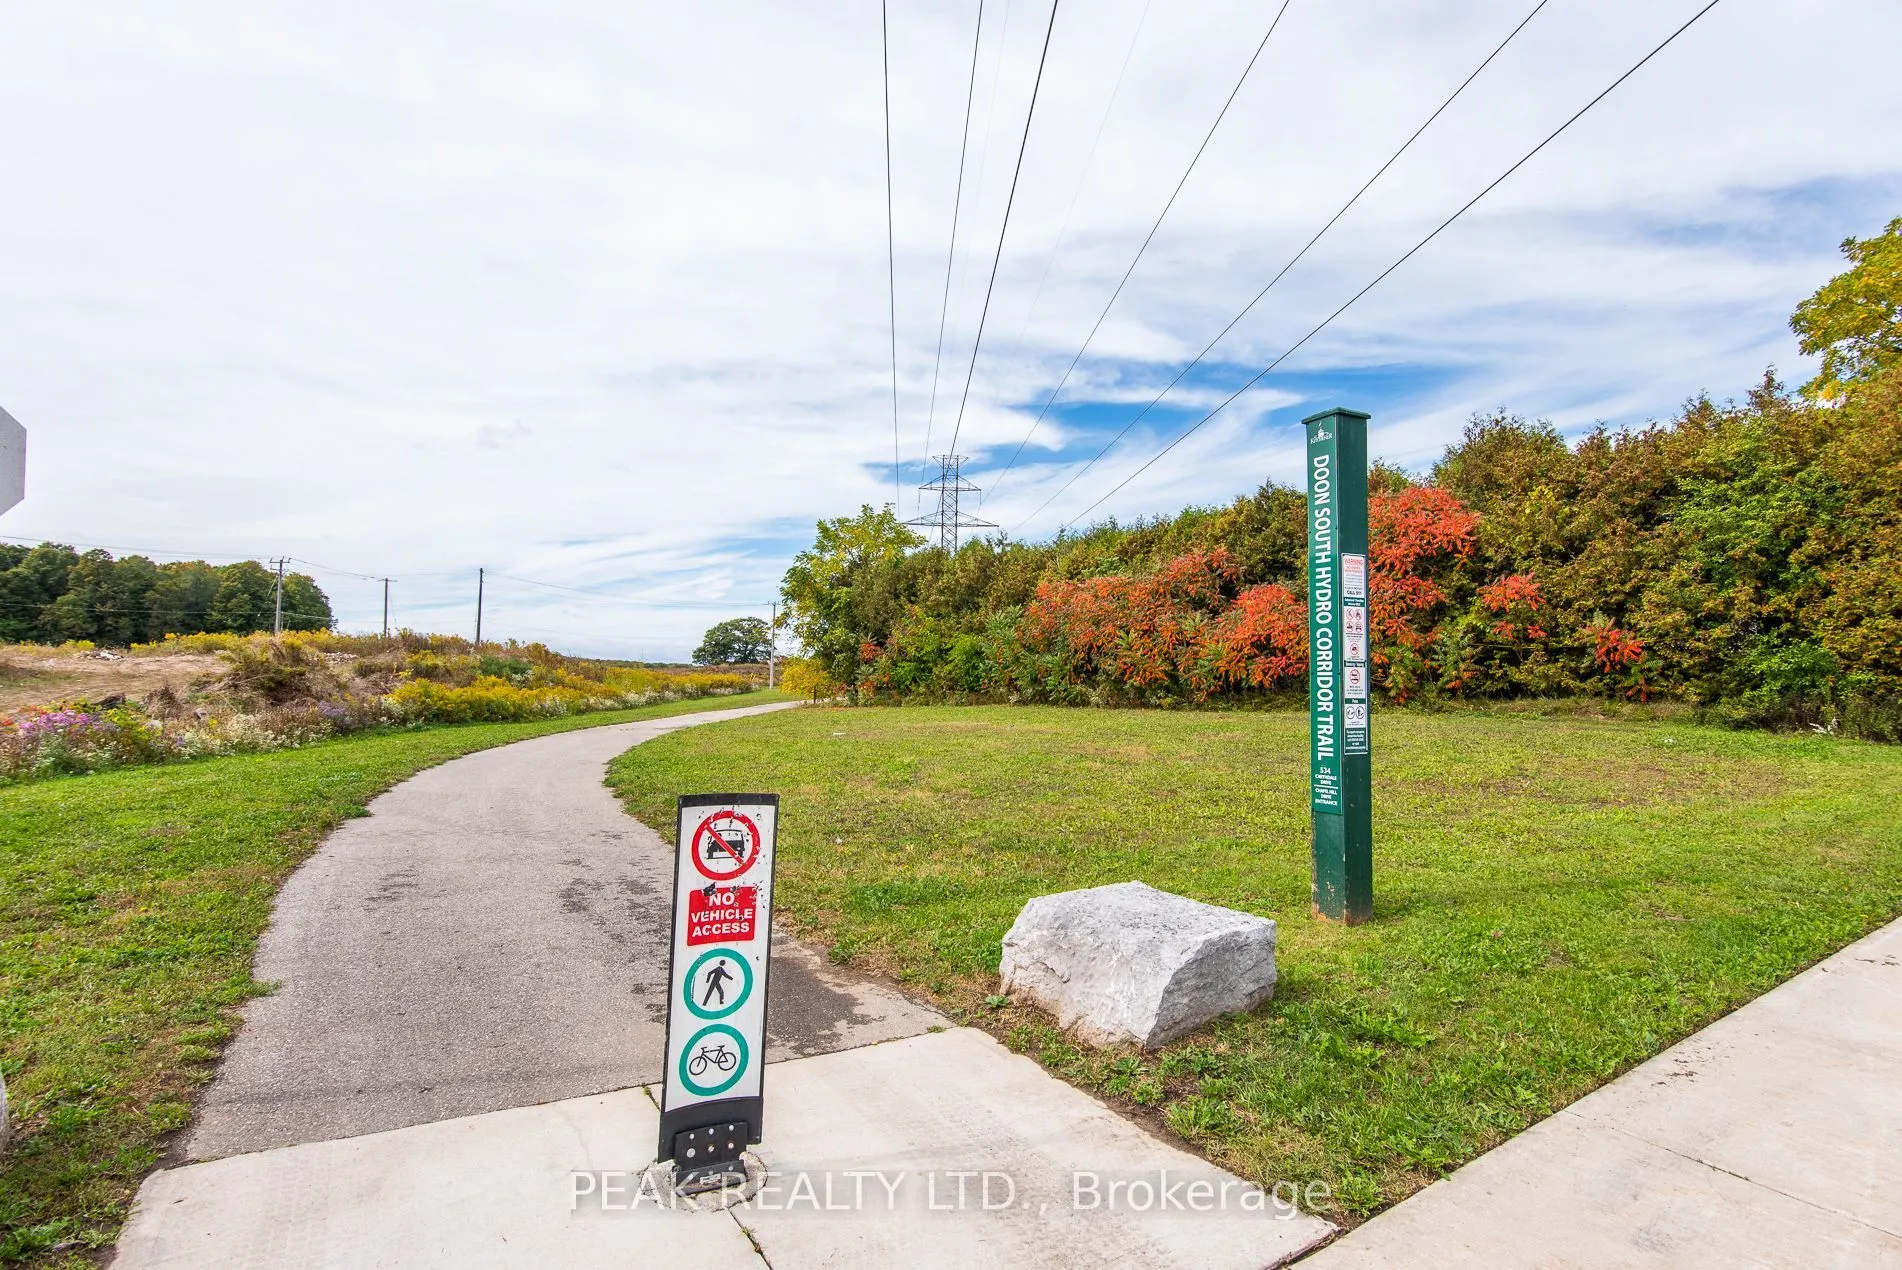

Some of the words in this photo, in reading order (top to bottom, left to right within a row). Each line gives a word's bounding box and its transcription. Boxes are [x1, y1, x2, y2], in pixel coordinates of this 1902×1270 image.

[1313, 454, 1330, 506] DOON
[1314, 508, 1332, 564] SOUTH
[1315, 566, 1333, 624] HYDRO
[1315, 627, 1334, 712] CORRIDOR
[1317, 715, 1334, 761] TRAIL
[1320, 766, 1331, 774] 534
[691, 908, 753, 923] VEHICLE
[709, 892, 735, 906] NO
[692, 922, 750, 937] ACCESS
